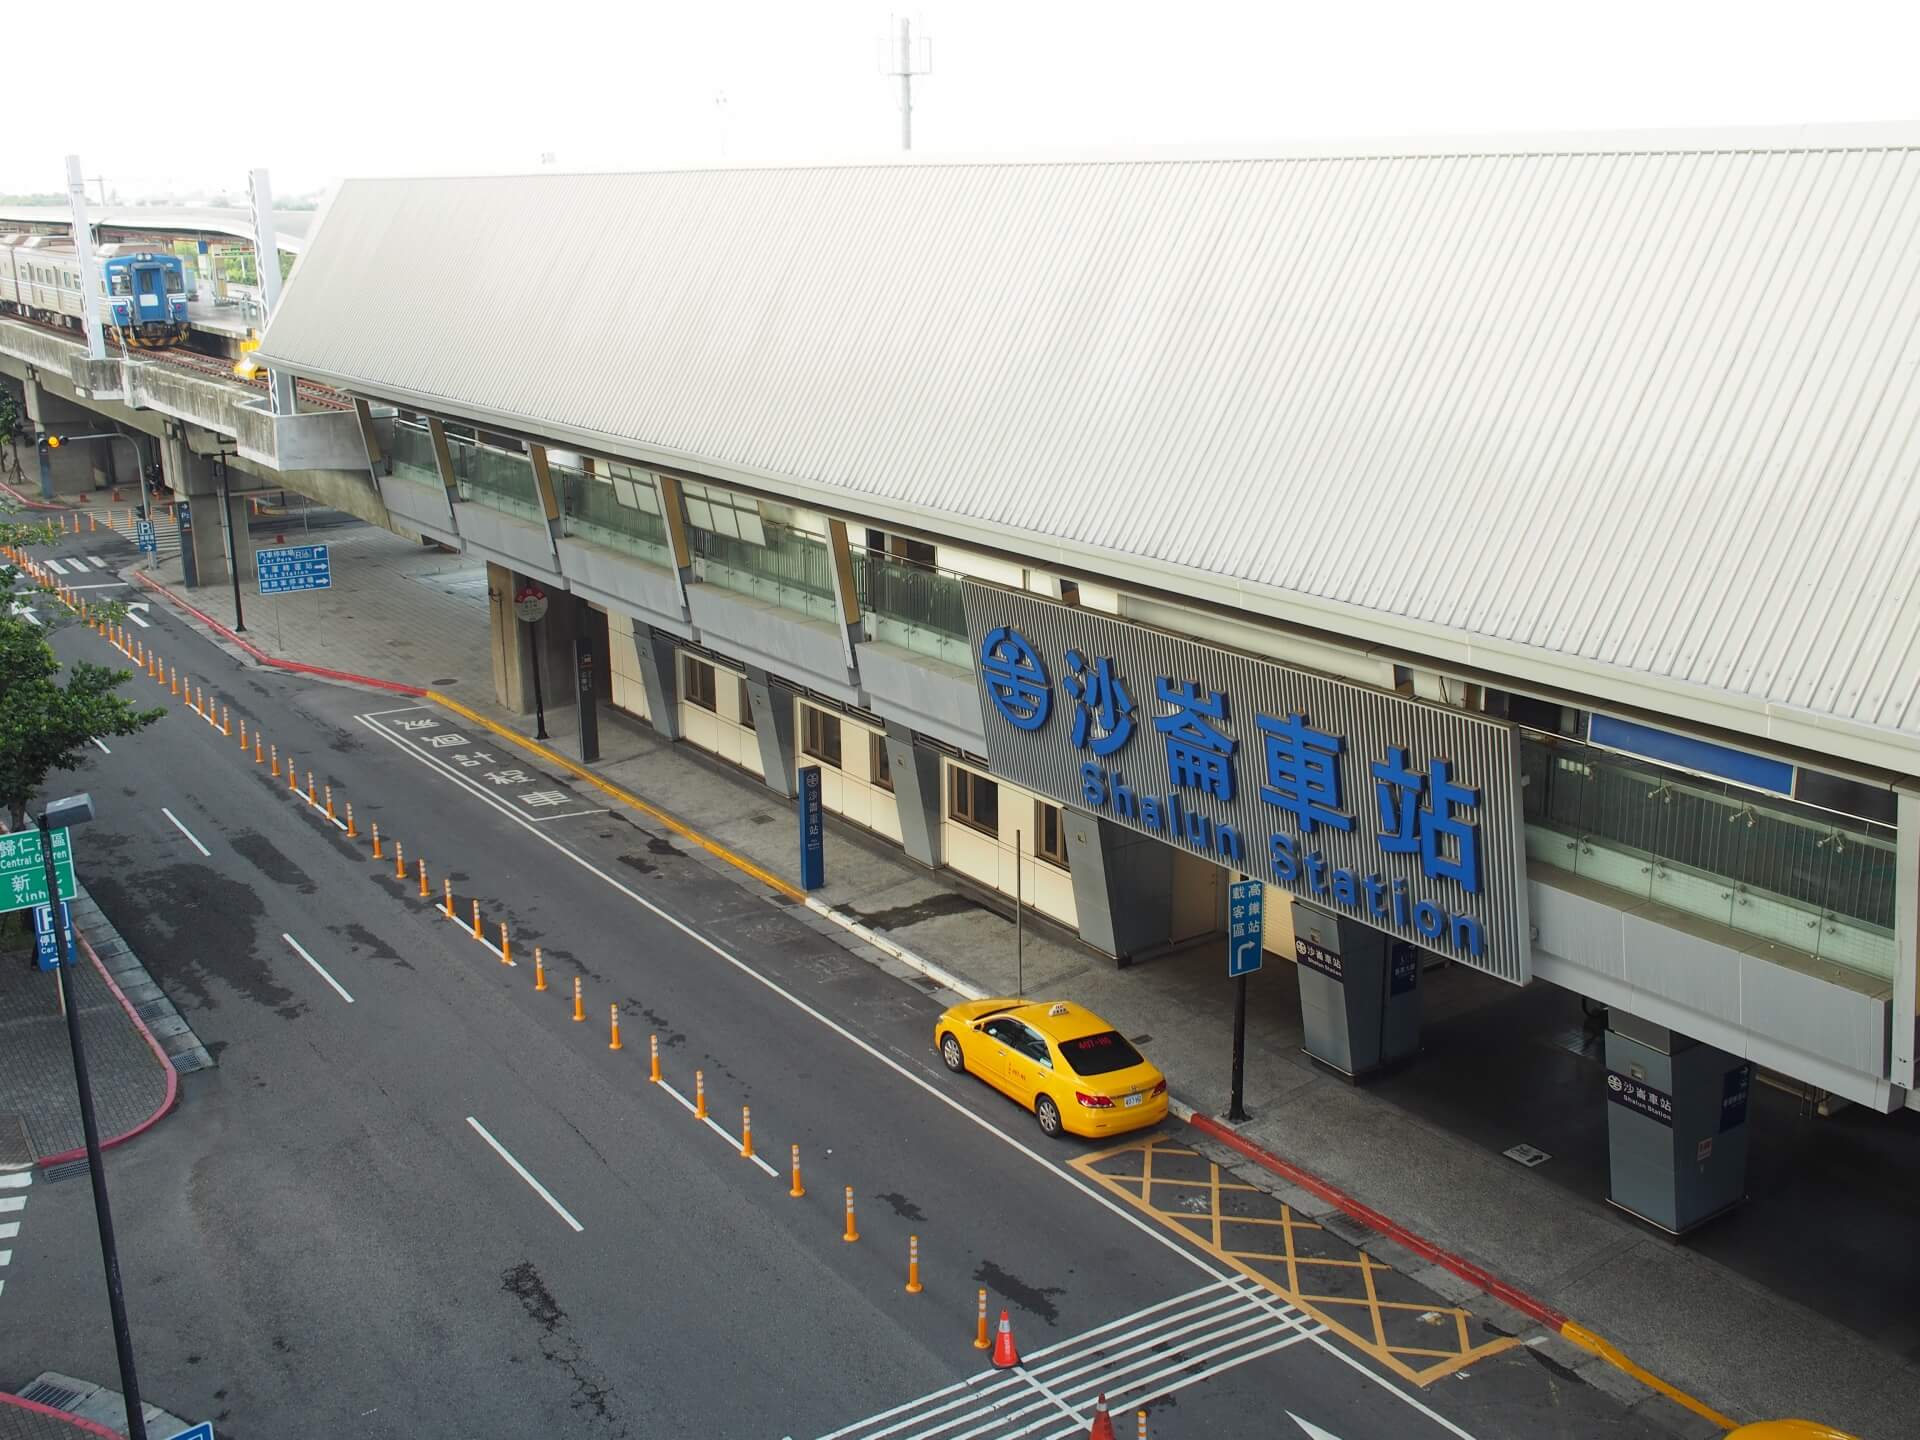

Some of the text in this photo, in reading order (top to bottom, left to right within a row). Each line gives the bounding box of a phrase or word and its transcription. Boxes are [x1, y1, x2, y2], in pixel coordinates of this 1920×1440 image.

[1063, 648, 1482, 894] 沙崙車站
[0, 855, 32, 869] Central
[1079, 760, 1487, 957] Shalun Station
[1232, 886, 1245, 938] 載客區
[1623, 1081, 1672, 1113] 沙崙車站
[1623, 1094, 1672, 1121] Shalun Station
